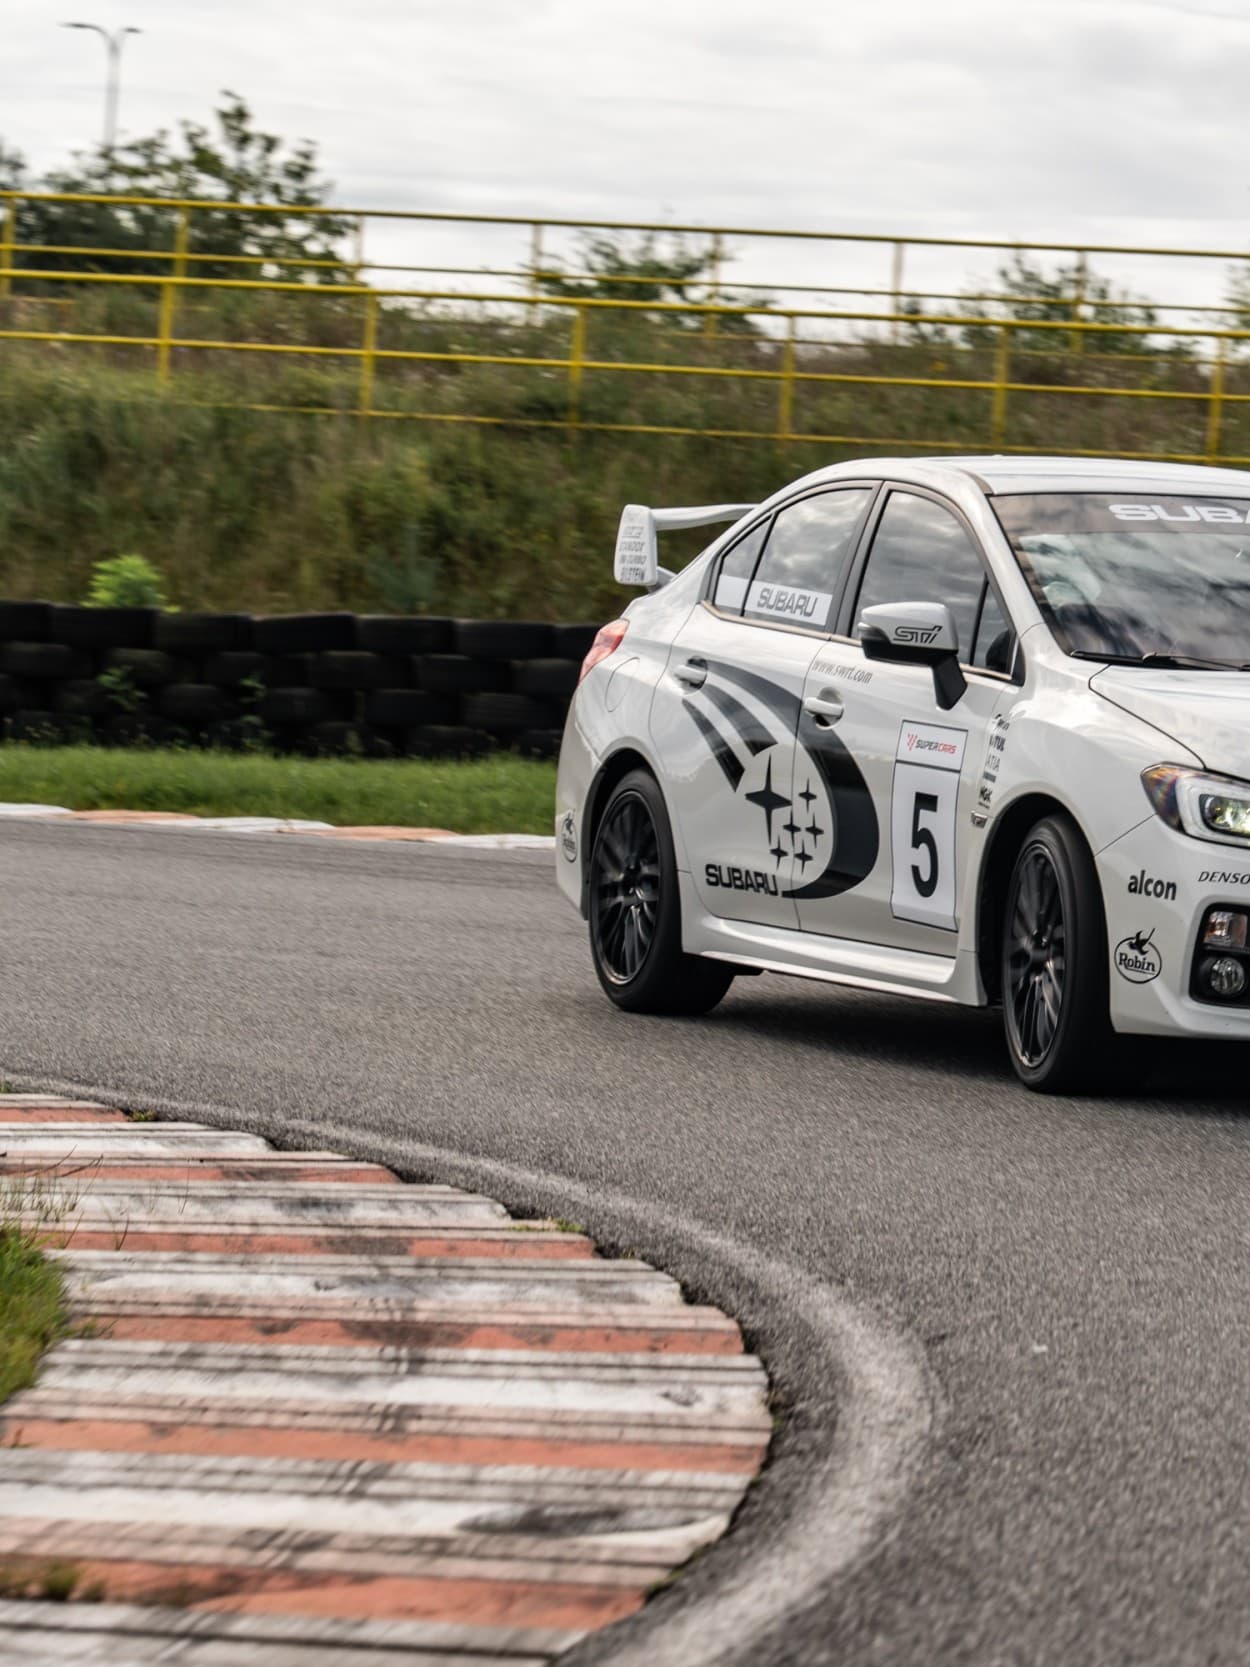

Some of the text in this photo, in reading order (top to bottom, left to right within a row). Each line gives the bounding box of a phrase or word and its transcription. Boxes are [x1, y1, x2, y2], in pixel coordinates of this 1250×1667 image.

[757, 587, 818, 617] SUBARU
[812, 660, 873, 684] www.swrt.com
[911, 792, 939, 898] 5
[705, 863, 779, 896] SUBARU
[1127, 870, 1177, 901] alcon
[1118, 952, 1156, 973] Robin
